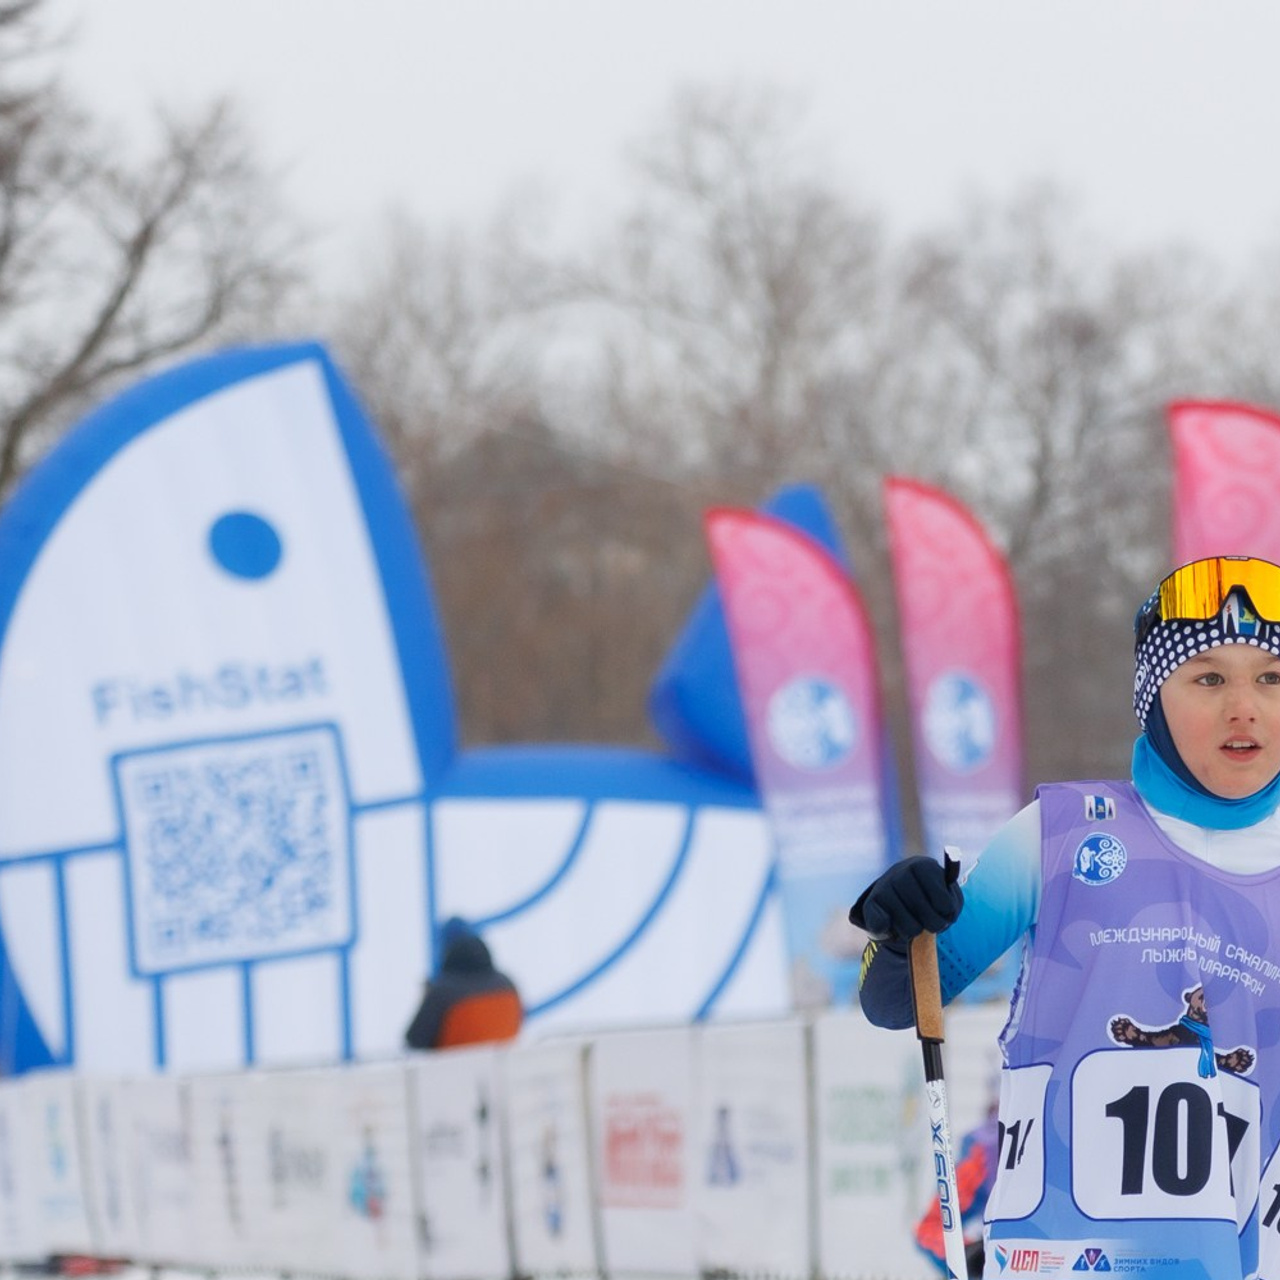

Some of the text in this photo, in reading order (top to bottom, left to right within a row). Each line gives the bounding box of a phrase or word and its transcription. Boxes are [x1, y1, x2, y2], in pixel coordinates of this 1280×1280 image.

[92, 656, 326, 724] FishStat
[1141, 948, 1266, 997] ЛЫЖН МАРАФОН
[1010, 1249, 1040, 1273] ЦСП
[1113, 1257, 1180, 1266] ЗИМНИХ ВИДОВ
[1113, 1265, 1147, 1273] СПОРТА
